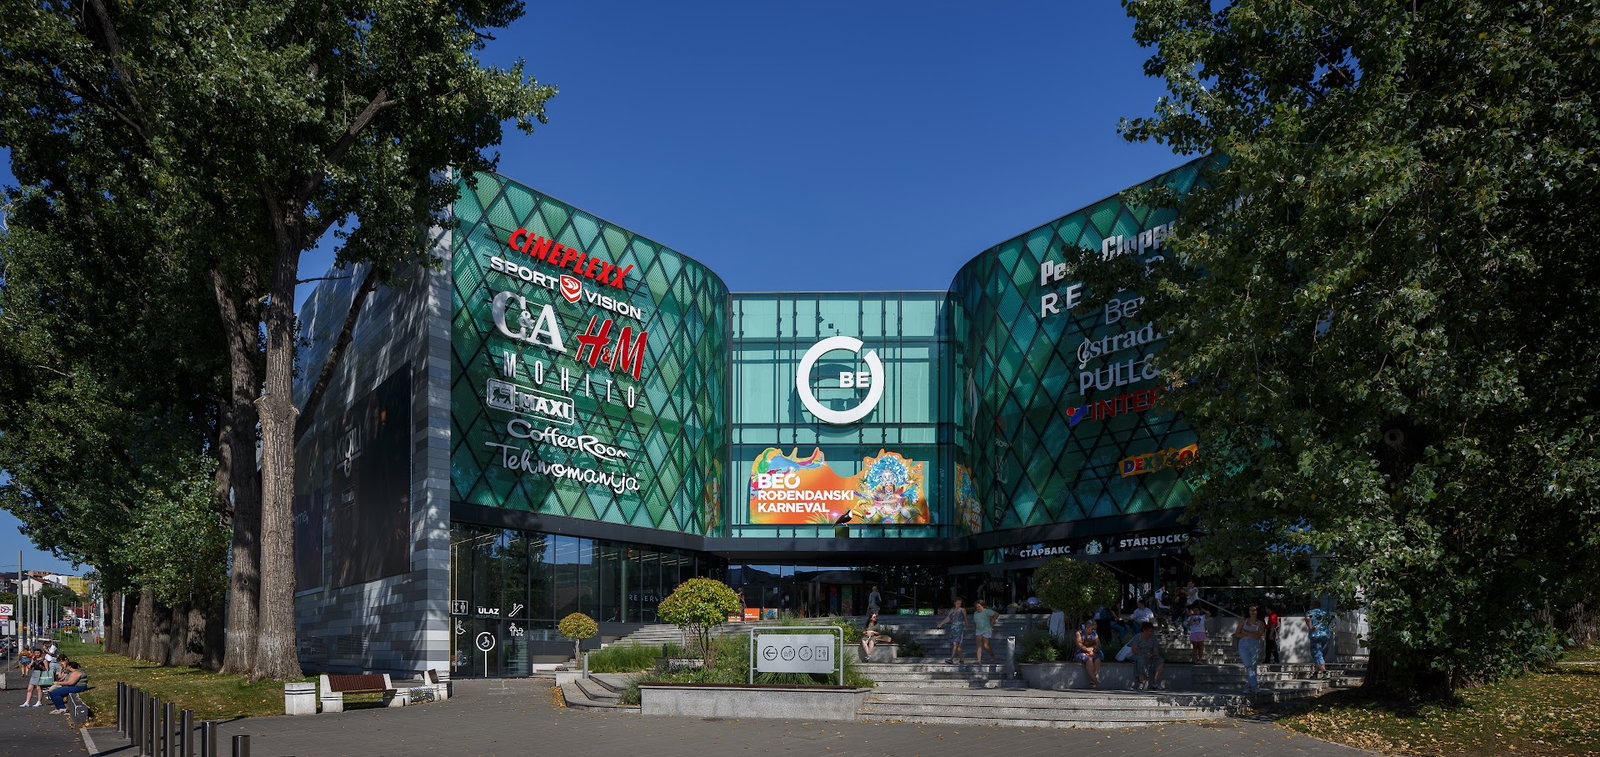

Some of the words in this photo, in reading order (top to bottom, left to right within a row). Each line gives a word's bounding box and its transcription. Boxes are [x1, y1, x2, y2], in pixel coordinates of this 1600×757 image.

[508, 228, 633, 290] CINEPLEXX
[490, 255, 559, 291] SPORT
[585, 290, 642, 320] VISION
[491, 291, 567, 353] C&A
[575, 314, 649, 381] H&M
[503, 351, 635, 409] MOHITO
[1079, 353, 1161, 396] PULL&
[518, 392, 572, 421] MAXI
[1092, 386, 1167, 421] INTER
[485, 442, 641, 494] Tehnomanija
[757, 473, 801, 489] BEO
[757, 490, 854, 501] ROĐENDANSKI
[757, 502, 830, 513] KARNEVAL
[1019, 545, 1071, 558] СТАРБАКС
[1119, 533, 1190, 548] STARBUCKS
[477, 607, 500, 615] ULAZ
